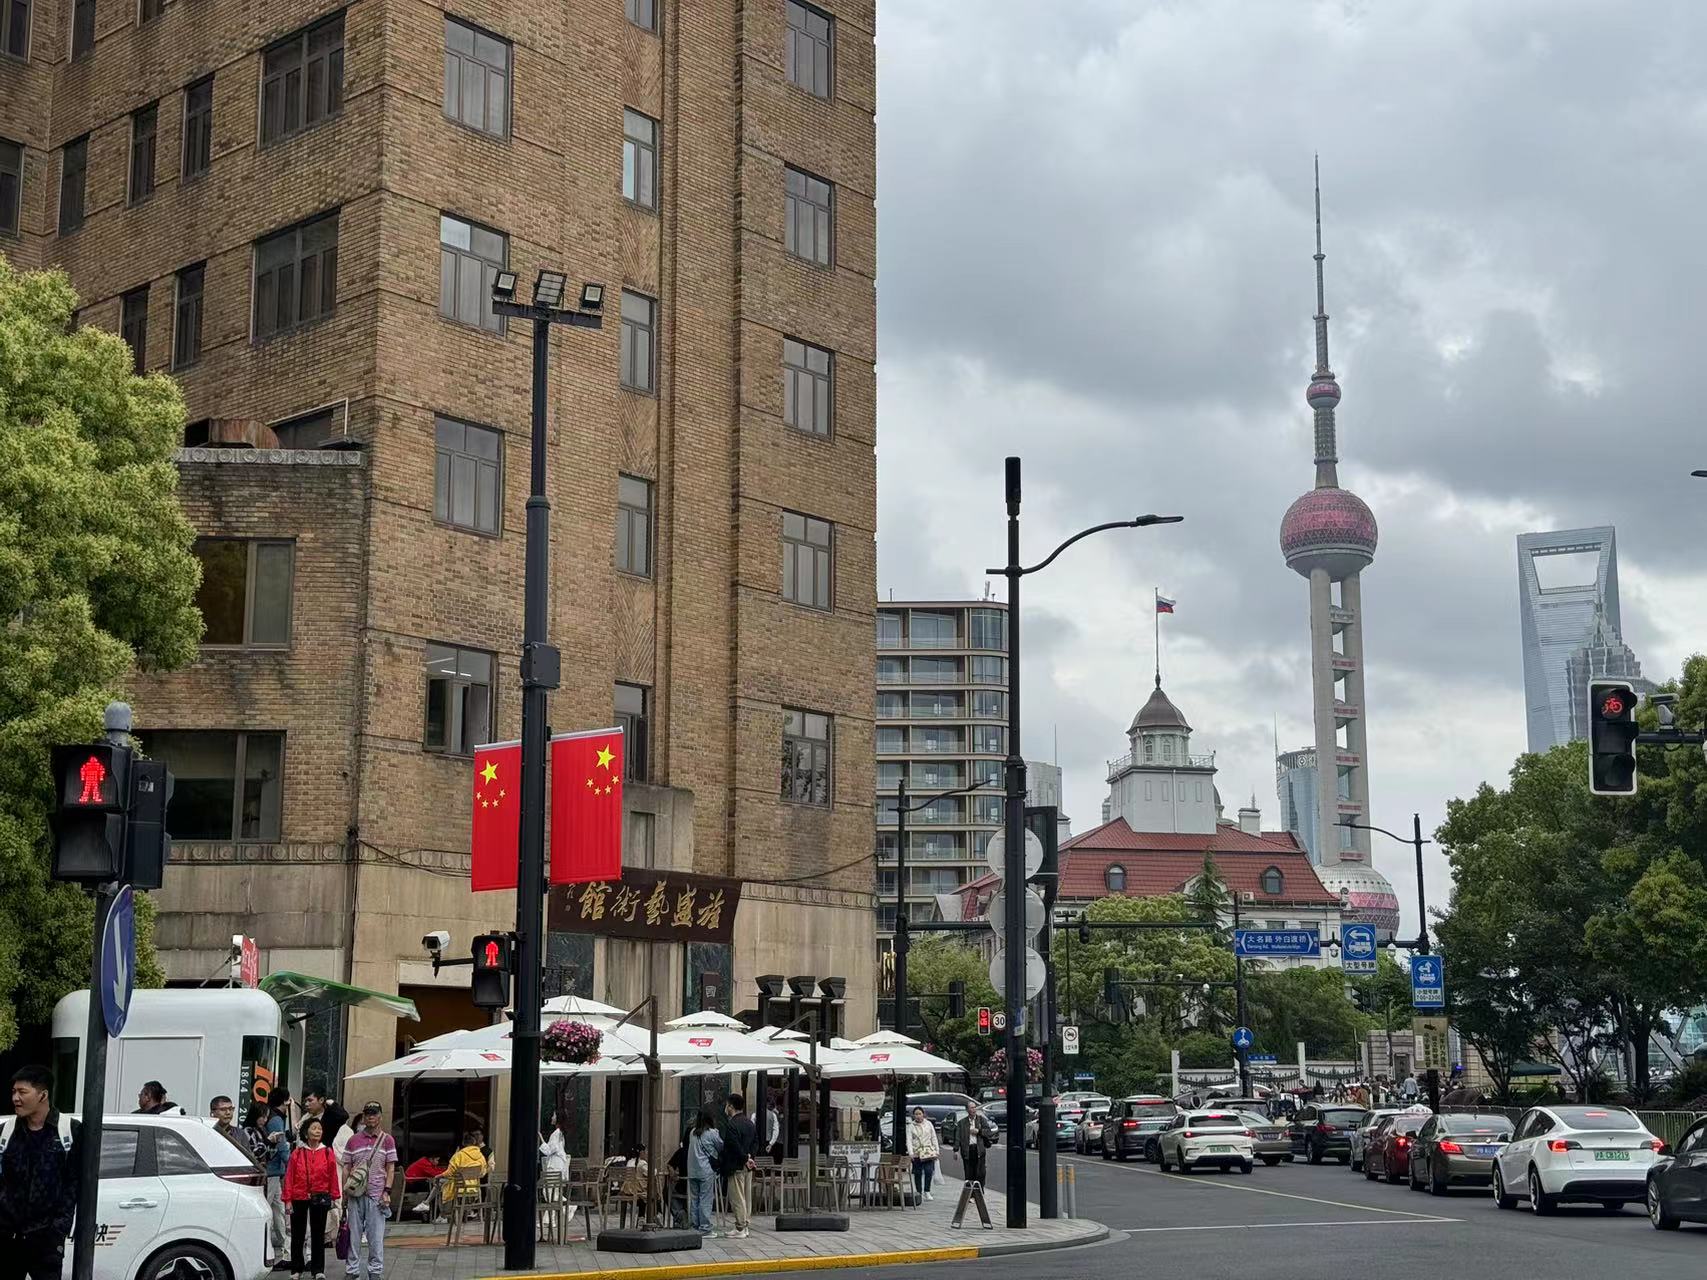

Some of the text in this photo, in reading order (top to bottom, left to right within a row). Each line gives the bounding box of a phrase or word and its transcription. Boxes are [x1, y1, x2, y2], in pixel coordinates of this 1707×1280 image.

[1247, 935, 1273, 943] 大名路
[1346, 961, 1375, 969] 大型号牌
[995, 1016, 1005, 1026] 30
